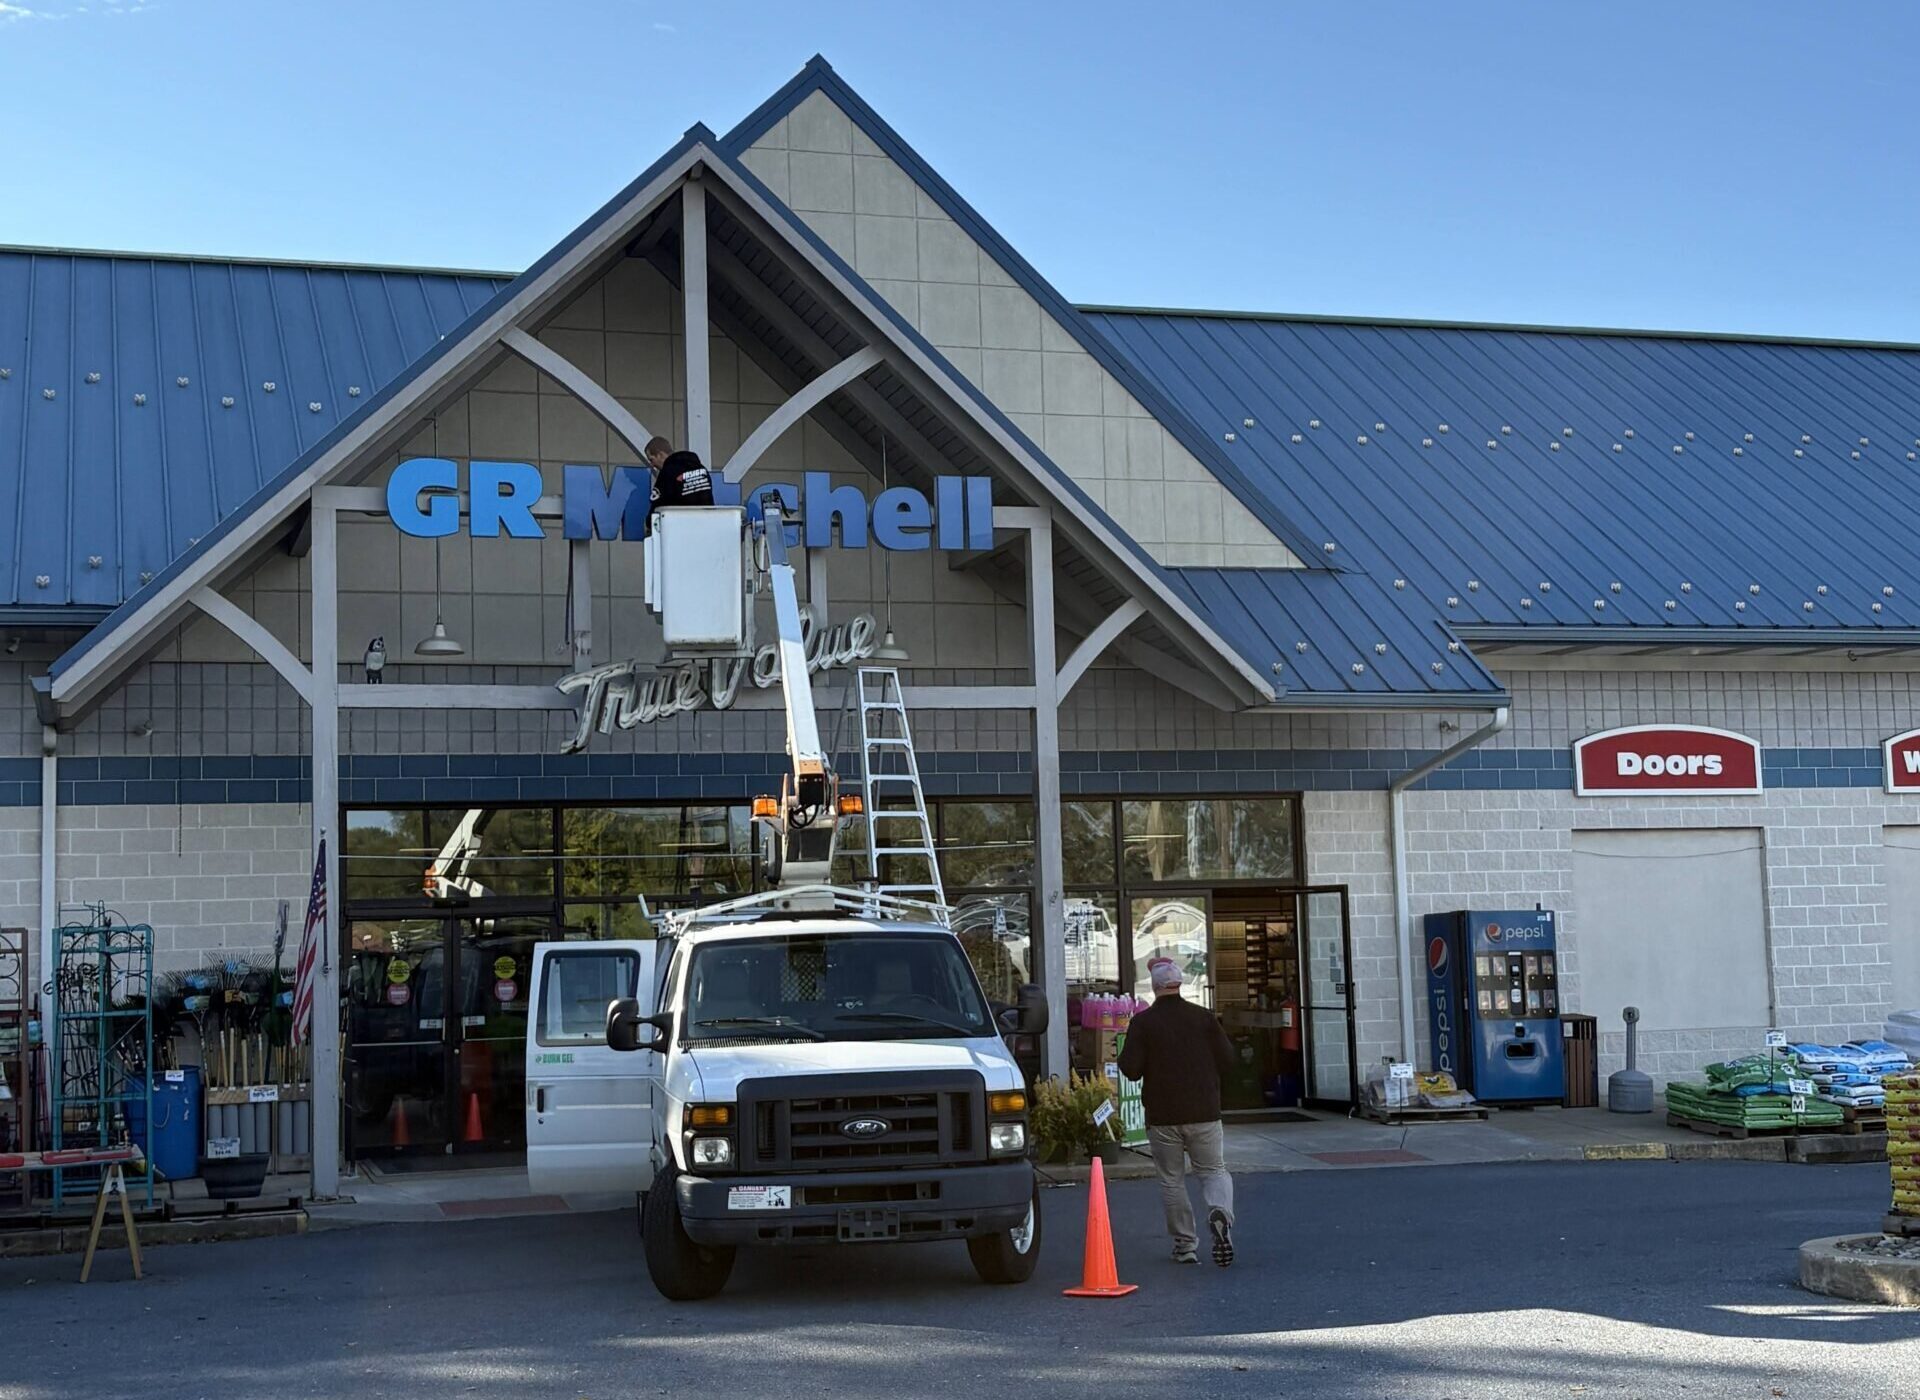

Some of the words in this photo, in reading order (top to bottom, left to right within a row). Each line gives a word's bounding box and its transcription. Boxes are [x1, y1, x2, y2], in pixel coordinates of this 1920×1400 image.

[386, 457, 545, 539] GR
[555, 658, 707, 754] True
[1616, 751, 1723, 776] Doors
[1505, 924, 1544, 941] pepsi
[1434, 989, 1453, 1073] pepsi
[1793, 1100, 1804, 1110] M
